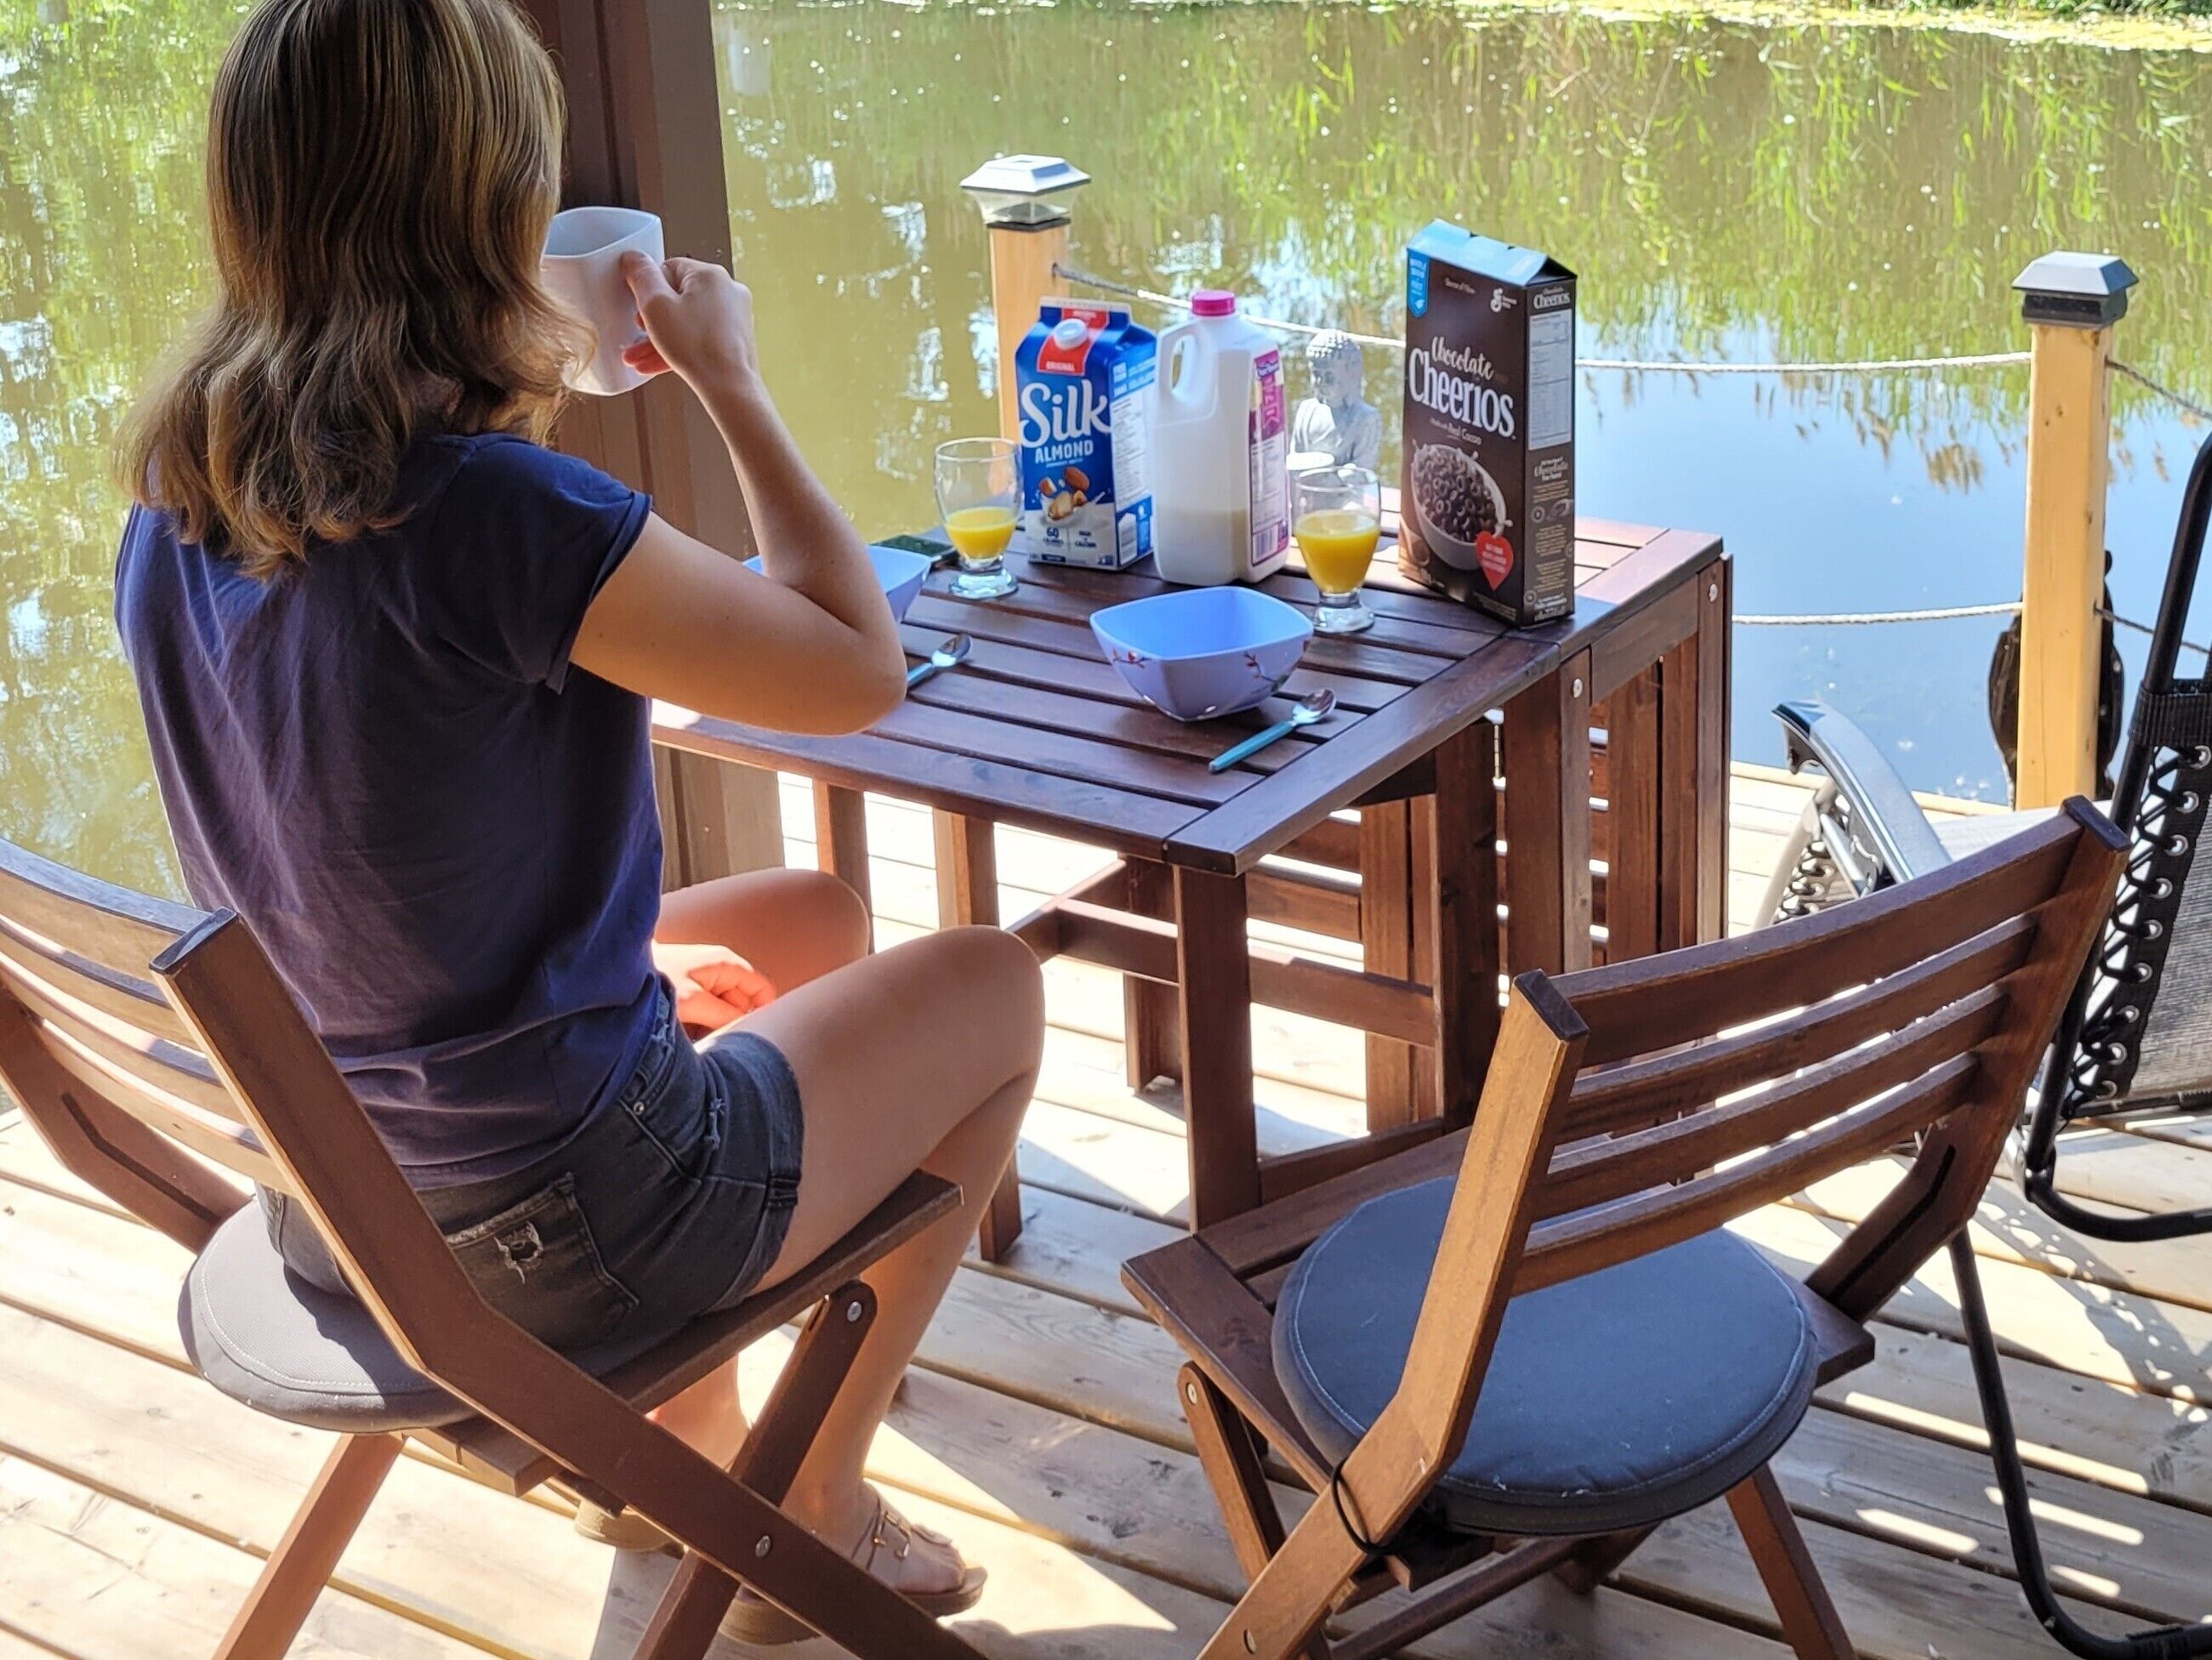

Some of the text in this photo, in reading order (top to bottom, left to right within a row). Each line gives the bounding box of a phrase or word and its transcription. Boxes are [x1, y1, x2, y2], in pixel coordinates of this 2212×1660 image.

[1431, 336, 1494, 381] Chocolate
[1019, 378, 1112, 448] Silk
[1408, 347, 1515, 437] Cheerios
[1035, 440, 1094, 463] ALMOND
